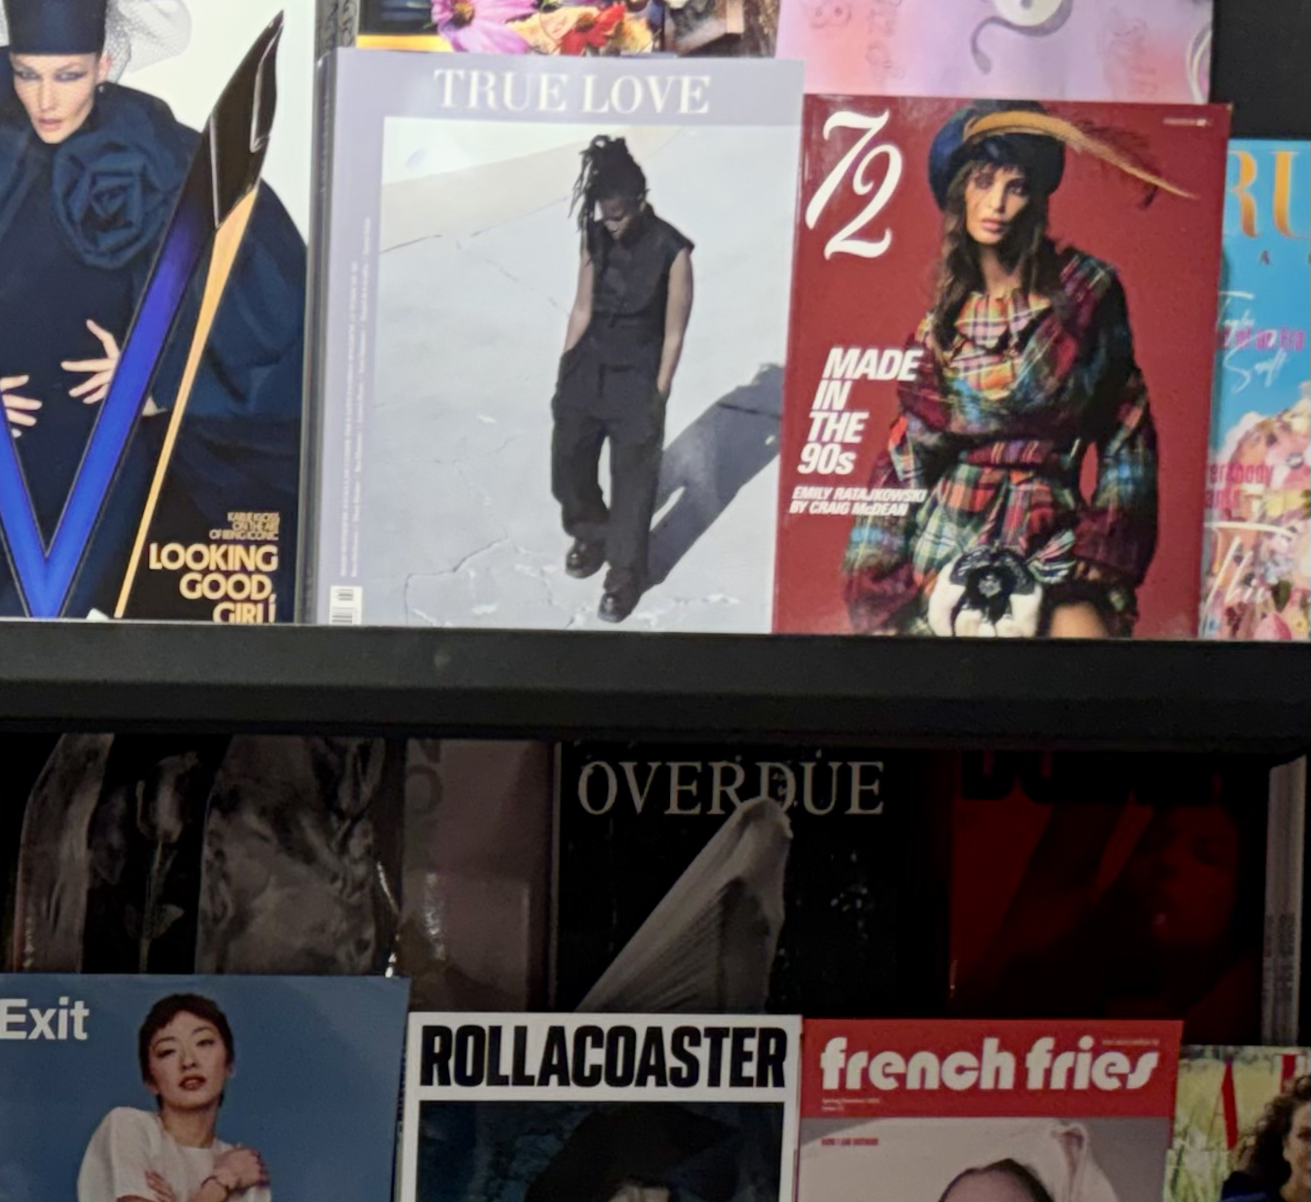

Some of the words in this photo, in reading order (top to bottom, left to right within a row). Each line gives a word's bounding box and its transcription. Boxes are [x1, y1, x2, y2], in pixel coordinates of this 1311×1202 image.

[434, 68, 567, 112] TRUE
[581, 73, 711, 115] LOVE
[805, 109, 903, 261] 72
[822, 347, 924, 382] MADE
[812, 380, 853, 411] IN
[807, 411, 870, 443] THE
[797, 443, 857, 475] 90s
[789, 501, 808, 514] BY
[792, 486, 834, 501] EMILY
[149, 542, 278, 572] LOOKING
[179, 571, 277, 604] GOOD,
[578, 757, 885, 816] OVERDUE
[419, 1024, 789, 1088] ROLLACOASTER
[820, 1036, 1016, 1091] french
[1026, 1034, 1160, 1091] fries
